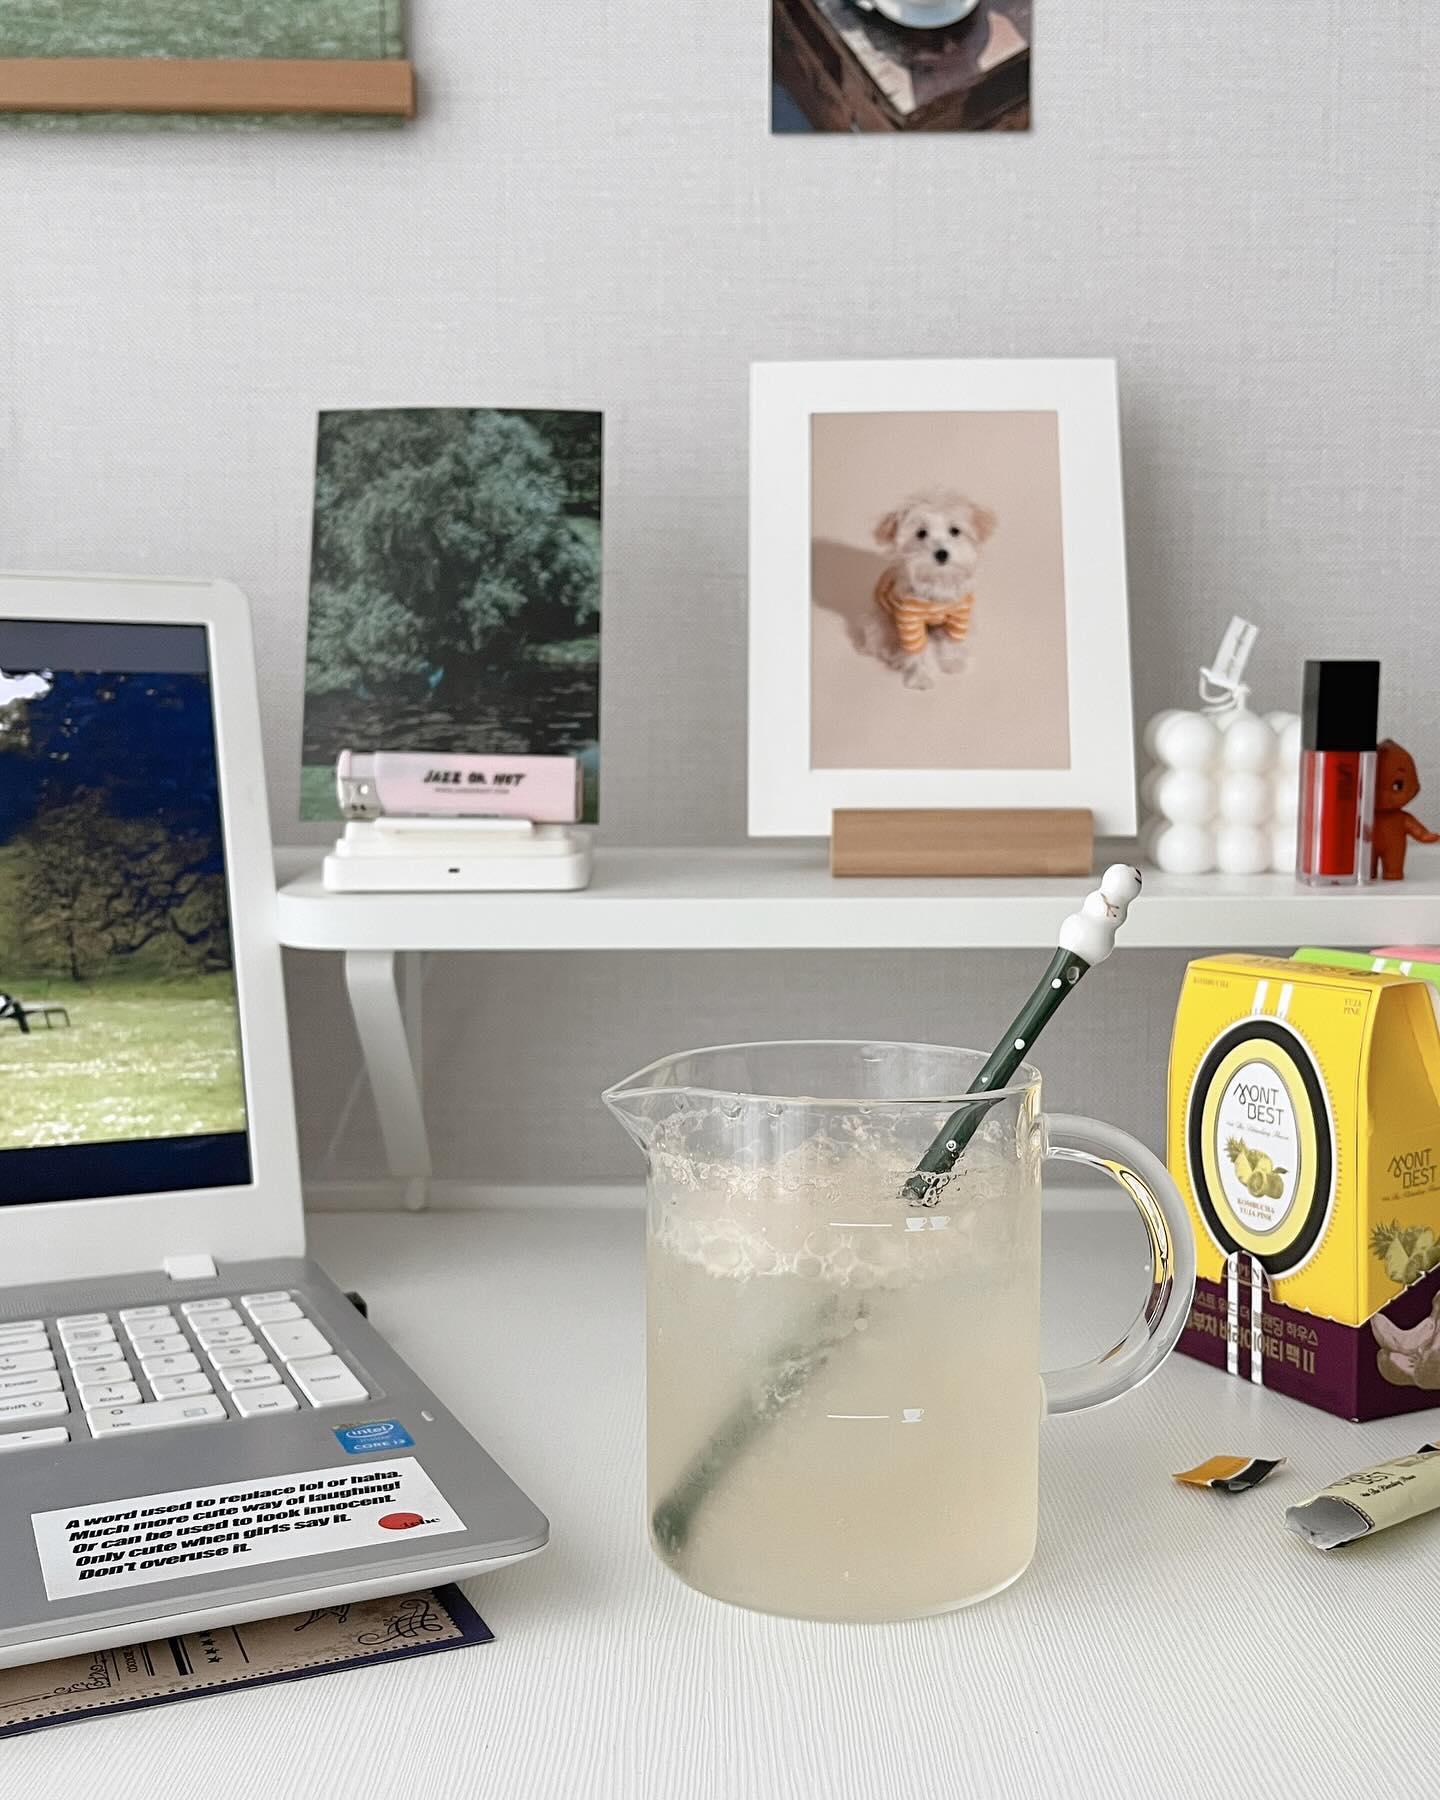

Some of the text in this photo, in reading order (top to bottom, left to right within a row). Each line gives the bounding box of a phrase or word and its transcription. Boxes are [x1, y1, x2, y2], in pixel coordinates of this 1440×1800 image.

[1233, 1083, 1279, 1106] MONT
[1247, 1103, 1284, 1126] BEST
[1387, 1148, 1432, 1178] MONT
[1403, 1165, 1437, 1189] BEST
[1286, 1322, 1319, 1346] 하우스
[1286, 1343, 1300, 1369] 팩
[65, 1471, 403, 1529] A word used to replace lol or haha.
[69, 1481, 401, 1542] Much more cute way of laughing!
[72, 1494, 396, 1553] Or can be used to look innocent.
[76, 1513, 352, 1567] Only cute when girls say it.
[78, 1543, 252, 1580] Don't overuse it.
